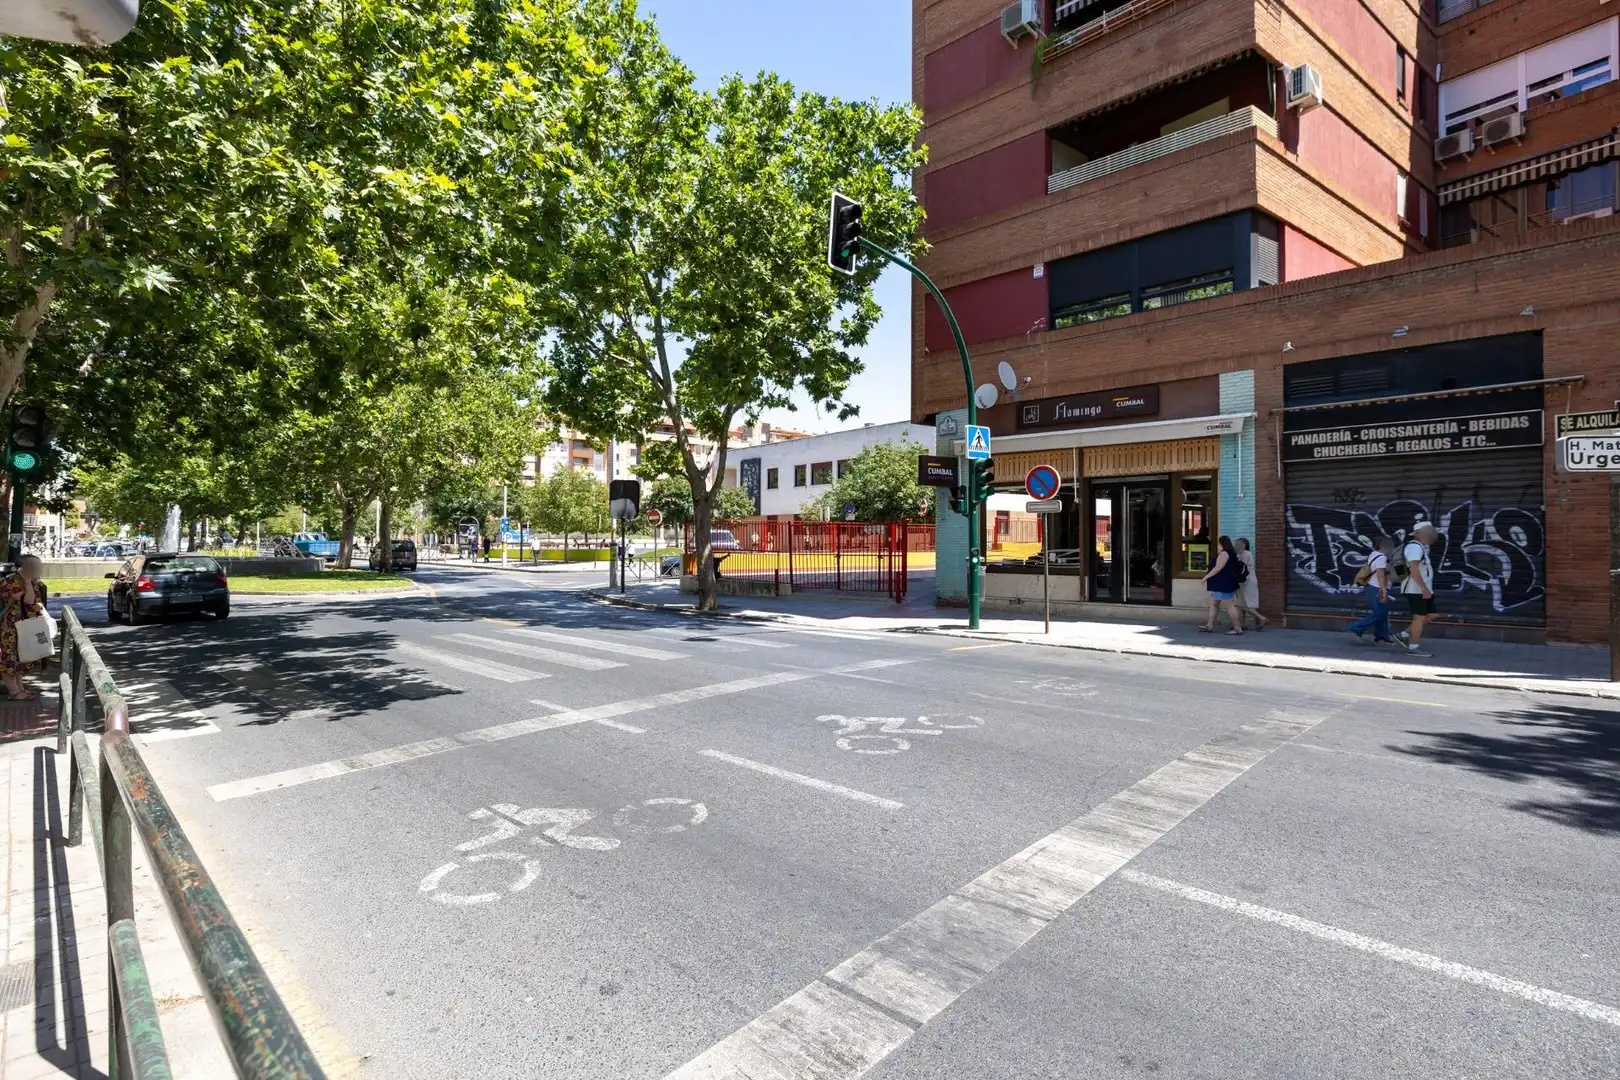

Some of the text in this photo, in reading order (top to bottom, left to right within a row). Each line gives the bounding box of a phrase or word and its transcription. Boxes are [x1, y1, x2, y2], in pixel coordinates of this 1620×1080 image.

[1116, 399, 1145, 408] CUMBAL
[1053, 402, 1102, 420] Flamingo
[1291, 429, 1352, 446] PANADERÍA
[1360, 420, 1459, 441] CROISSANTERÍA
[1469, 416, 1530, 432] BEBIDAS
[1560, 418, 1574, 430] SE
[1313, 441, 1387, 458] CHUCHERÍAS
[1396, 437, 1451, 452] REGALOS
[1462, 434, 1497, 448] ETC...
[1570, 441, 1587, 451] H.
[1570, 452, 1620, 468] Urge
[927, 467, 953, 476] CUMBAL
